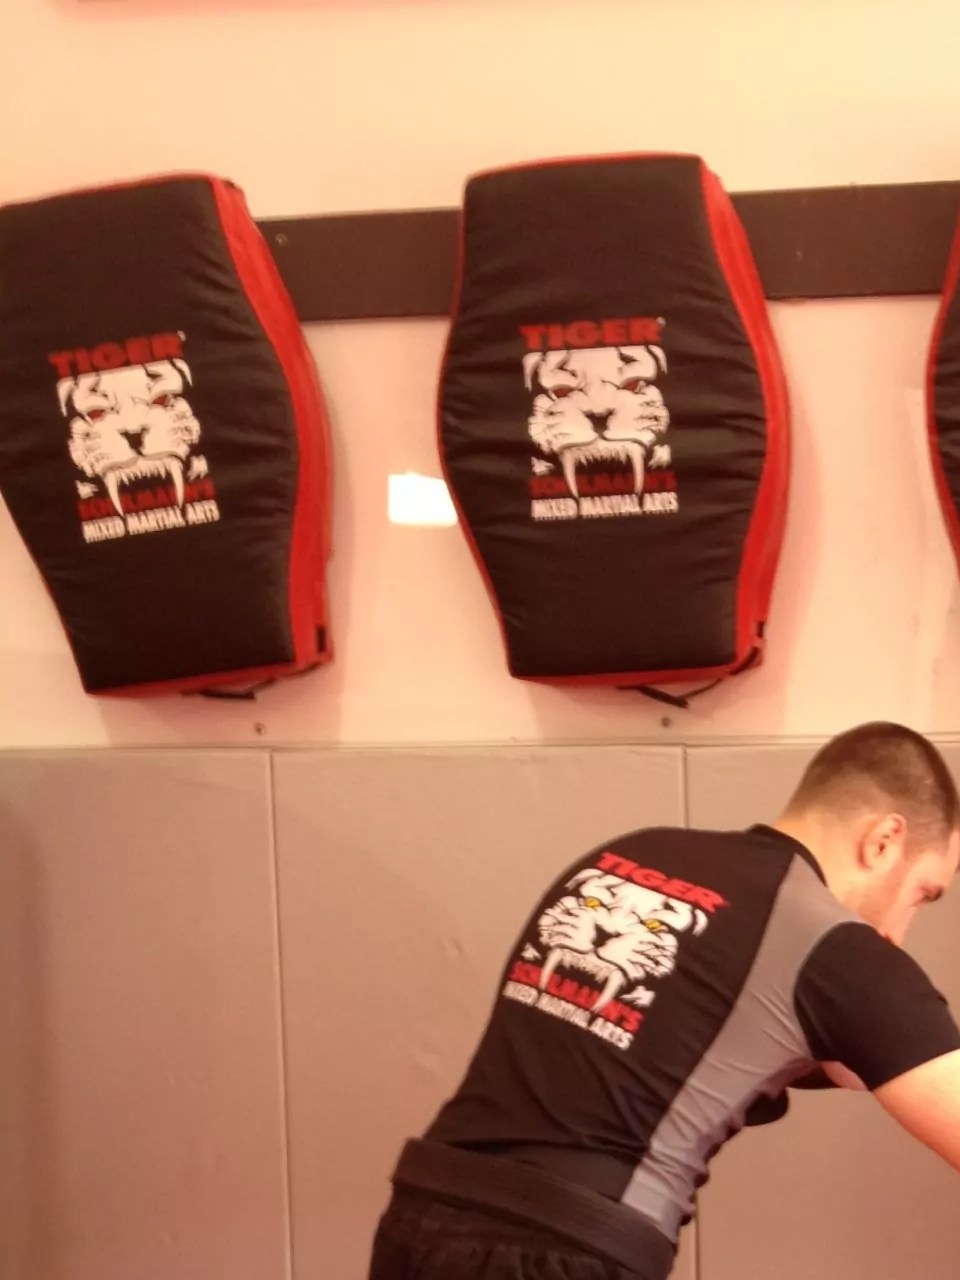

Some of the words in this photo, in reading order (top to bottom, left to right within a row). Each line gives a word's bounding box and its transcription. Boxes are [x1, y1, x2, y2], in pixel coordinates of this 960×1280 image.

[48, 333, 183, 378] TIGER
[519, 317, 662, 350] TIGER
[82, 516, 125, 543] MIXED
[126, 505, 186, 535] MARTIAL
[185, 499, 220, 525] ARTS
[531, 498, 578, 521] MIXED
[578, 494, 642, 519] MARTIAL
[642, 492, 680, 514] ARTS
[595, 851, 726, 914] TIGER
